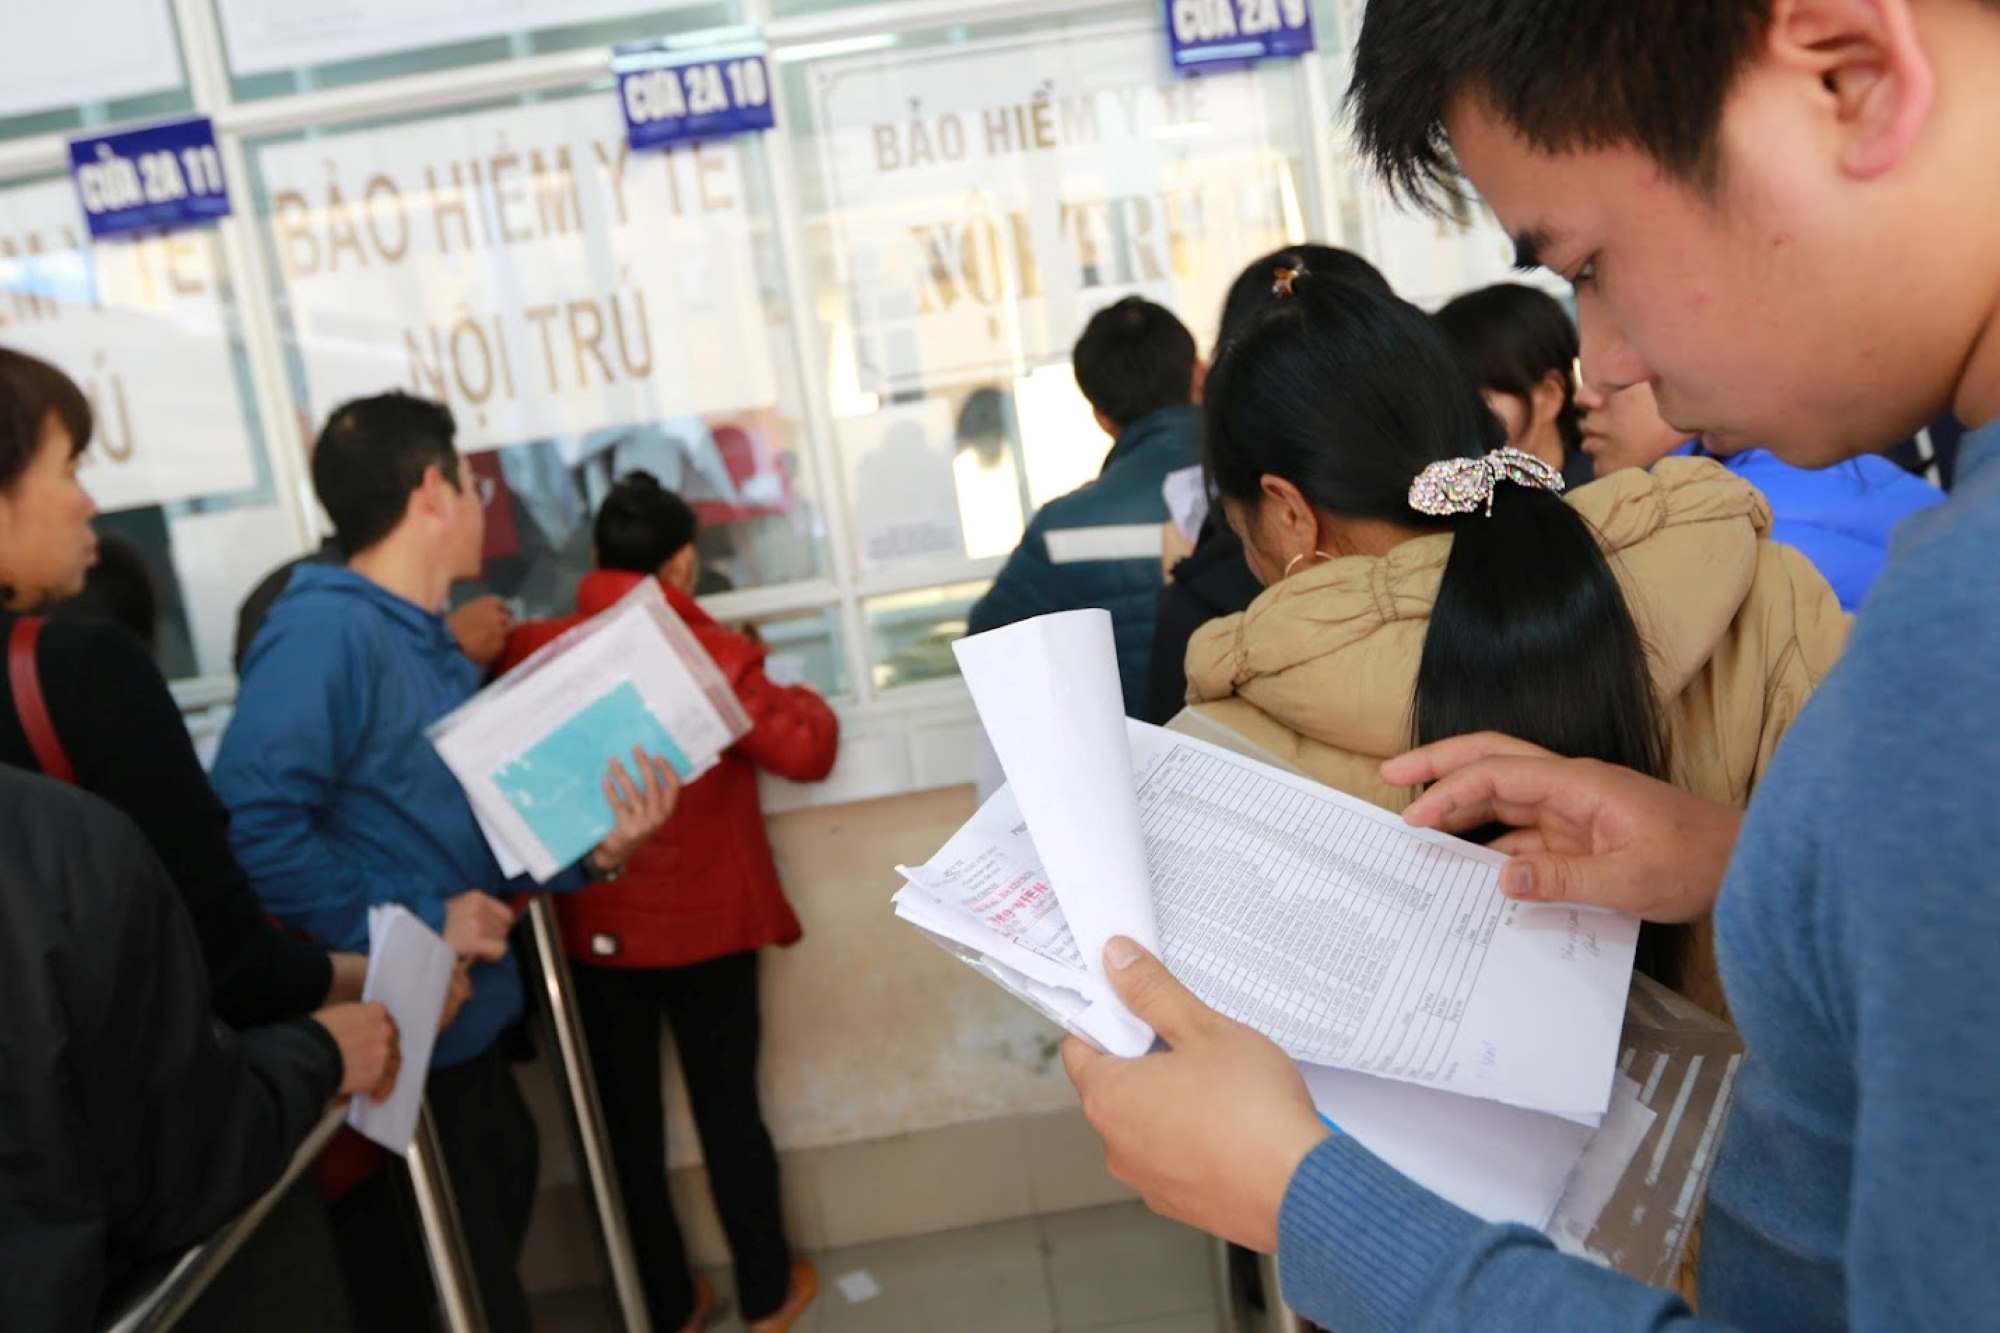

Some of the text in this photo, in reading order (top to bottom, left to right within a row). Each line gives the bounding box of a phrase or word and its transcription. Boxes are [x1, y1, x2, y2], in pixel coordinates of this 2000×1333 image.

[685, 63, 730, 115] 2A
[728, 58, 767, 108] 10
[138, 150, 188, 203] 2A
[182, 144, 224, 196] 11
[591, 136, 629, 226] Y
[523, 262, 655, 394] TRÚ
